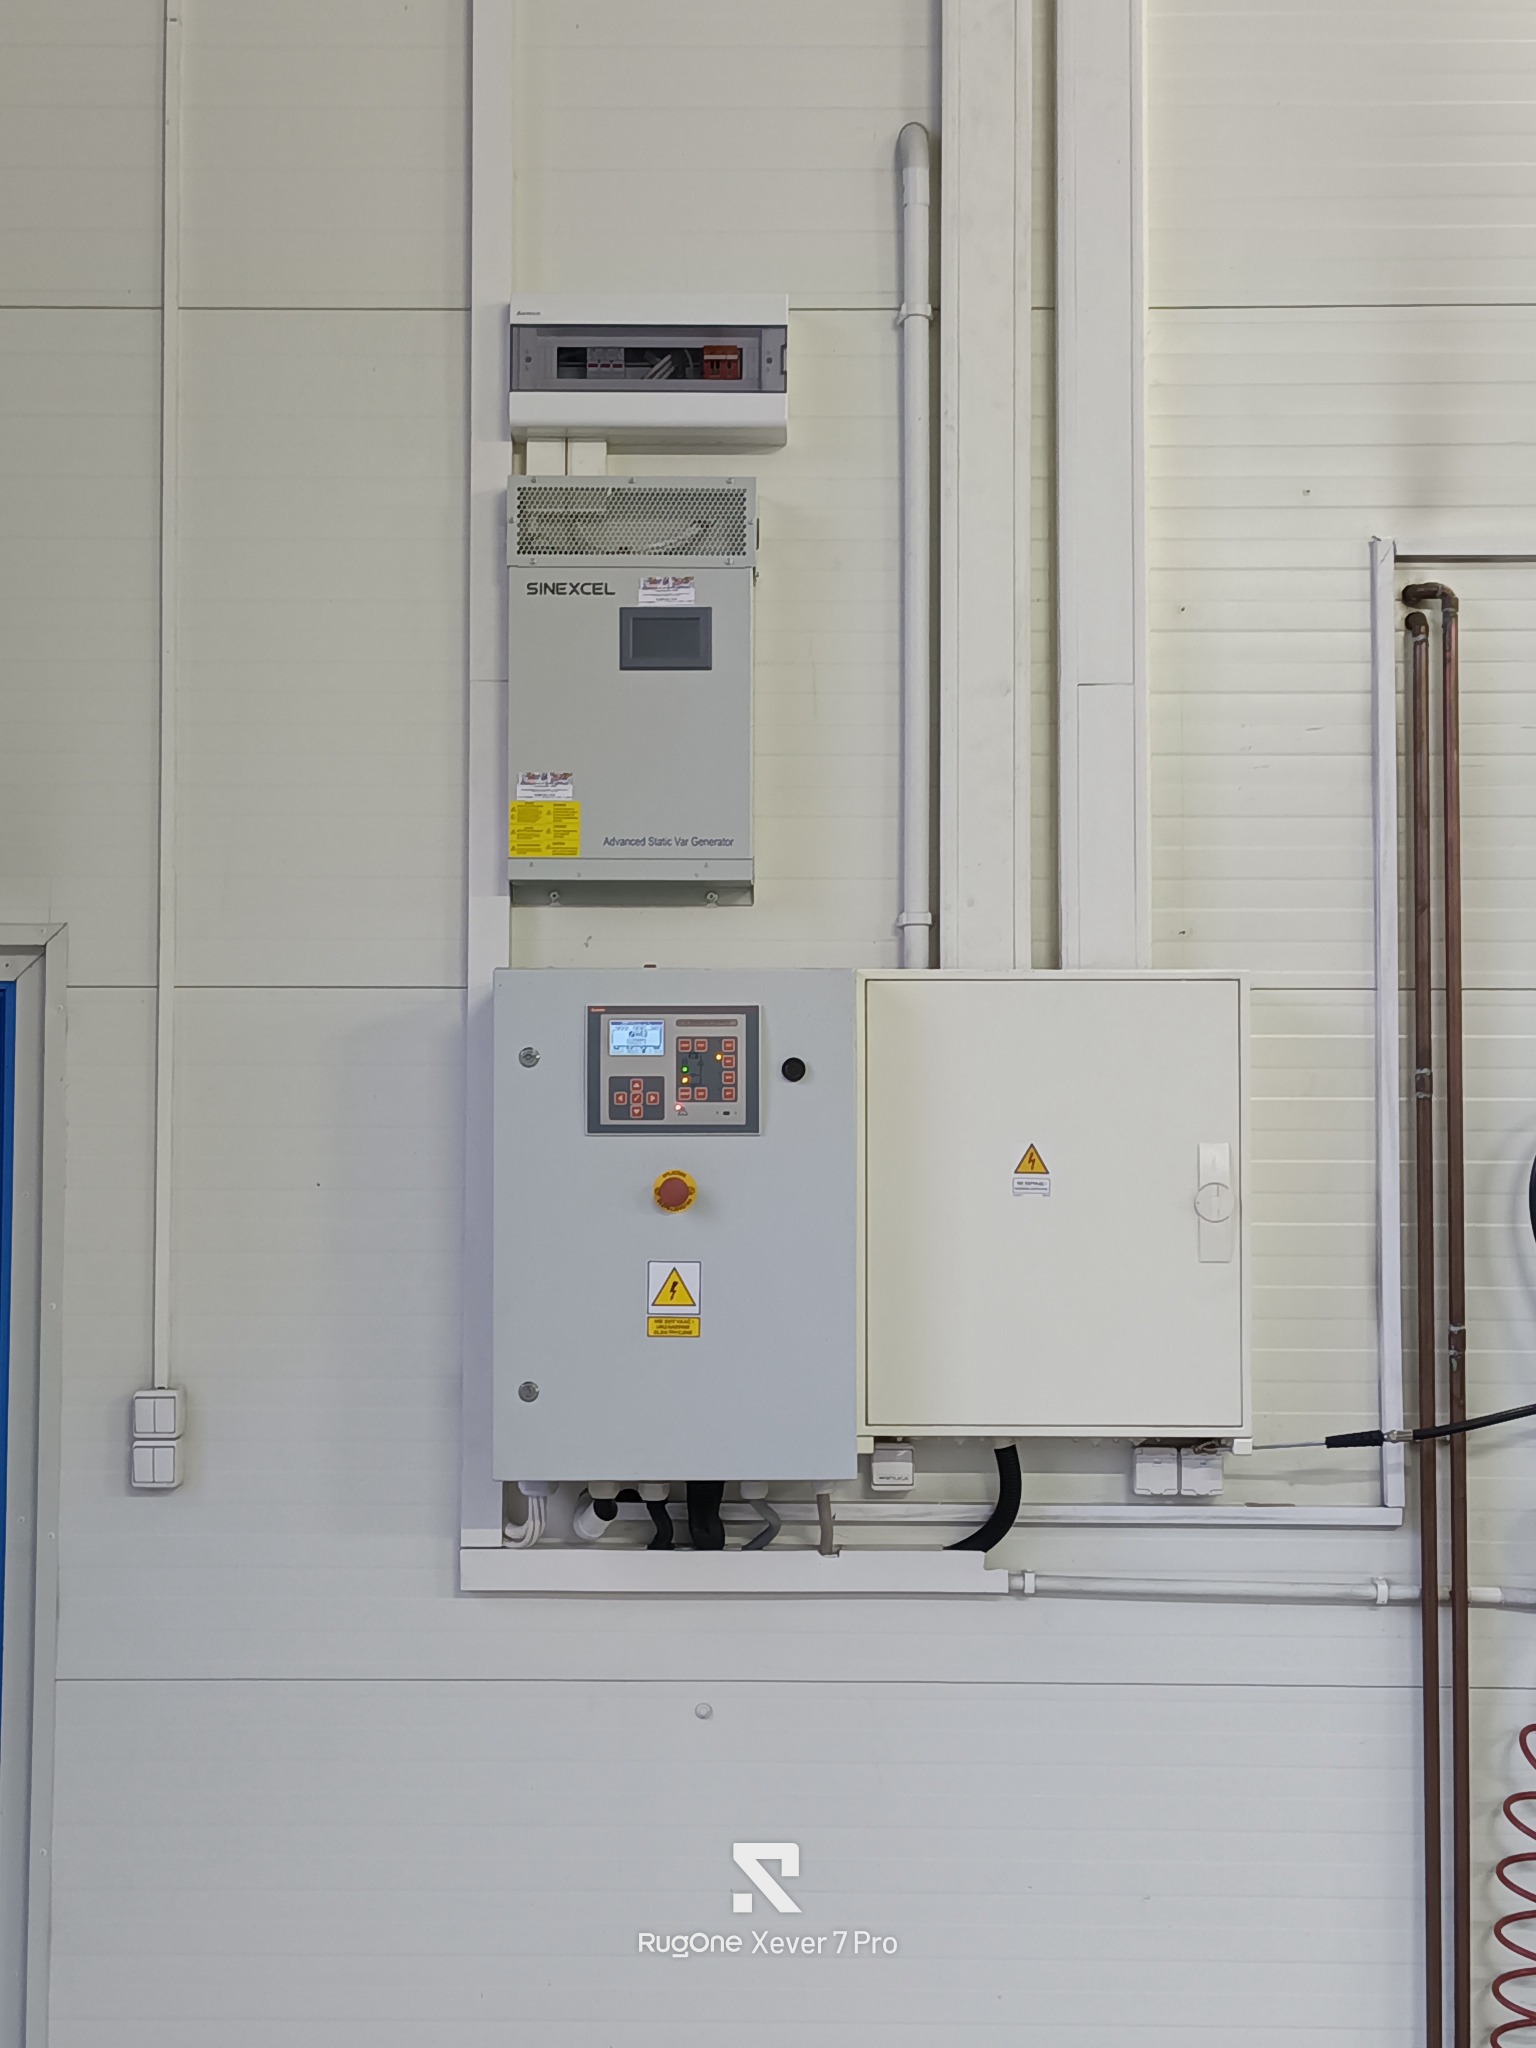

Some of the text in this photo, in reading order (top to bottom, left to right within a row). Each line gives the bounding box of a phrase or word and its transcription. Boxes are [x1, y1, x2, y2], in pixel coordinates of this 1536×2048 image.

[526, 582, 616, 596] SINEXCEL
[603, 836, 735, 847] Advanced Static Var Generator
